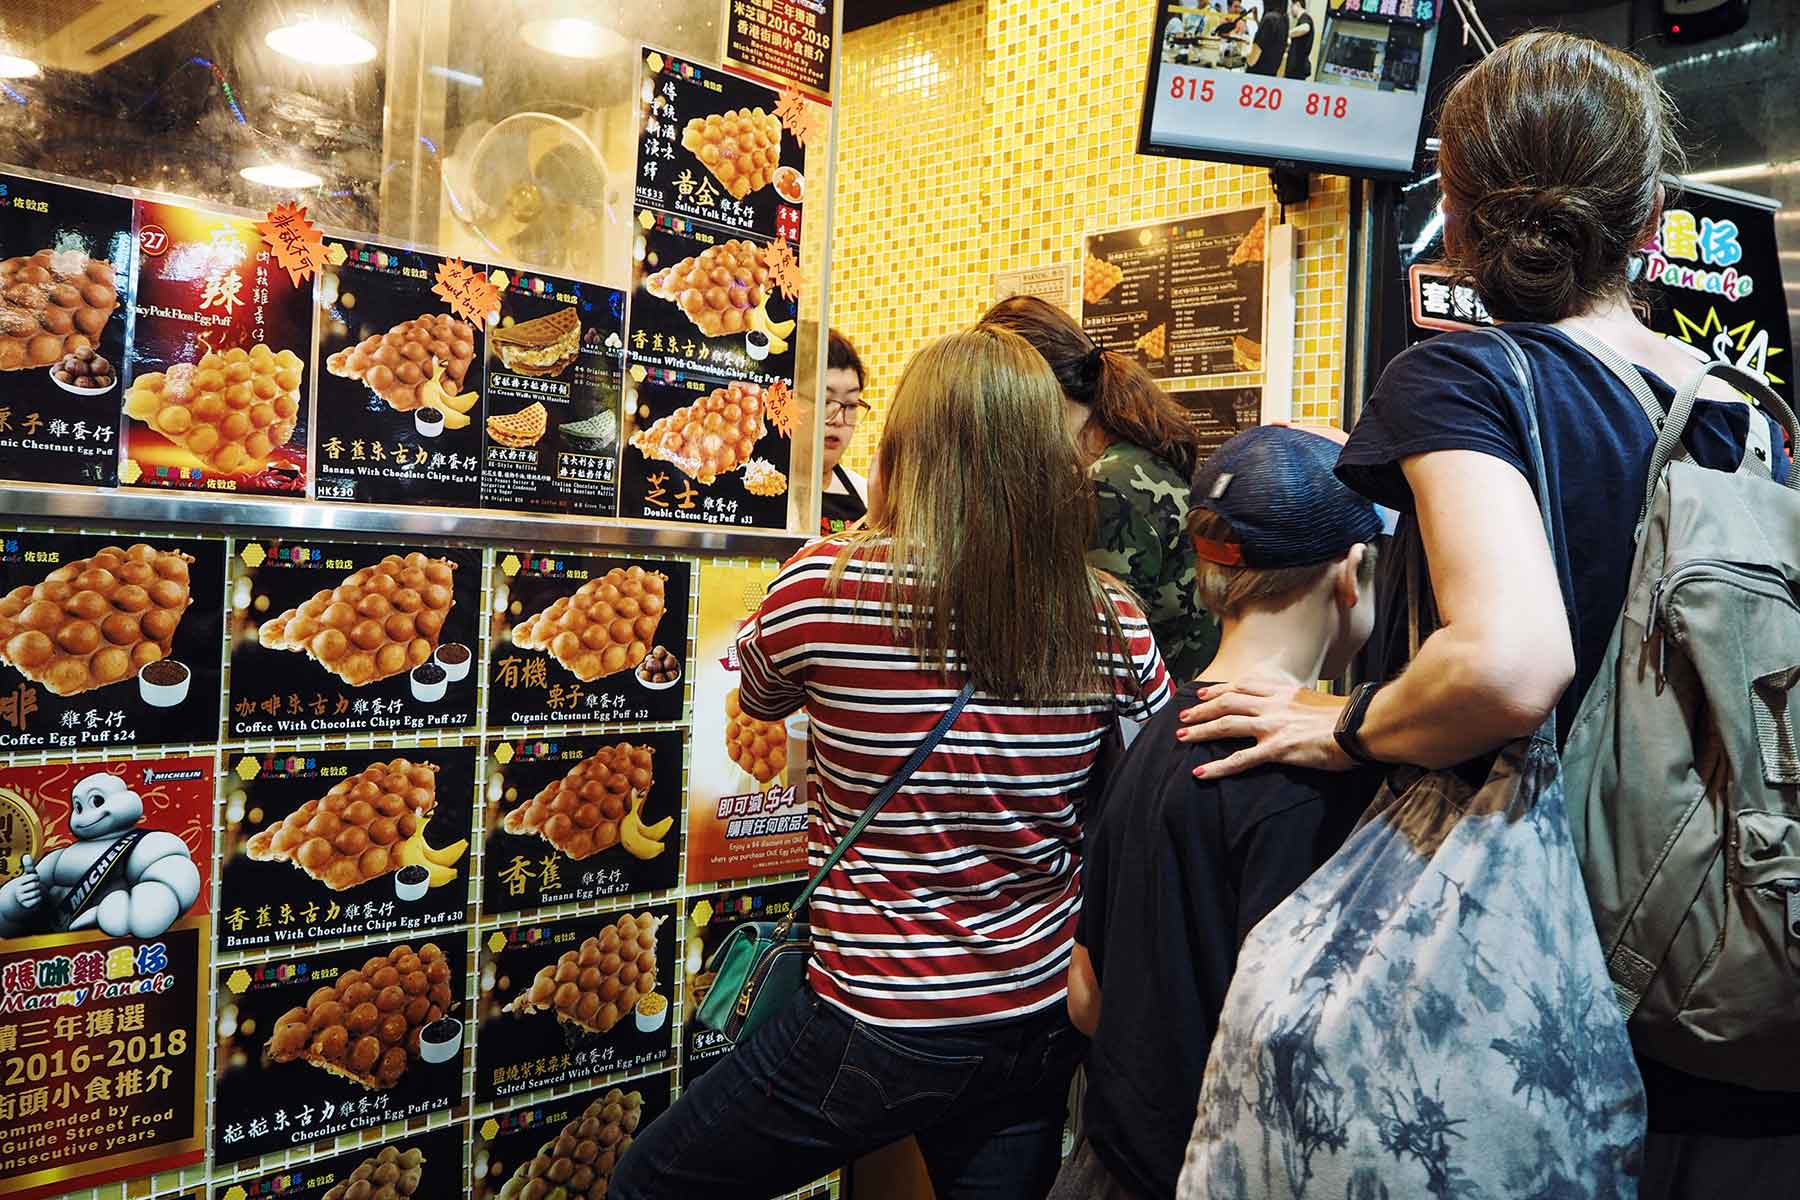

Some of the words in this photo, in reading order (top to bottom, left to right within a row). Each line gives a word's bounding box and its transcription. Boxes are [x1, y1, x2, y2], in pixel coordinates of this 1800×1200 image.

[732, 41, 763, 58] Michelin
[757, 58, 798, 77] consecutive
[1170, 76, 1215, 102] 815
[1239, 84, 1282, 110] 820
[1305, 92, 1347, 118] 818
[672, 168, 720, 207] 黃金
[674, 200, 700, 214] Salted
[702, 206, 720, 220] Yolk
[721, 212, 737, 226] Egg
[140, 231, 165, 249] $27
[1648, 253, 1754, 302] Pancake
[150, 305, 172, 319] Pork
[172, 308, 194, 321] Floss
[194, 311, 212, 327] Egg
[212, 314, 233, 327] Puff
[632, 351, 662, 364] Banana
[749, 371, 763, 384] Egg
[22, 439, 74, 453] Chestnut
[77, 446, 94, 456] Egg
[96, 447, 114, 456] Puff
[322, 464, 355, 475] Banana
[357, 466, 380, 476] With
[382, 468, 425, 480] Chocolate
[426, 471, 450, 483] Chips
[451, 473, 464, 483] Egg
[317, 486, 354, 497] HK$30
[644, 471, 699, 509] 芝士
[644, 507, 673, 518] Double
[674, 509, 701, 521] Cheese
[703, 512, 718, 524] Egg
[720, 513, 736, 523] Puff
[495, 655, 548, 690] 有機
[59, 708, 126, 729] 雞蛋仔
[235, 721, 273, 733] Coffee
[277, 720, 308, 731] With
[310, 718, 367, 730] Chocolate
[369, 716, 401, 729] Chips
[403, 715, 425, 728] Egg
[427, 713, 450, 725] Puff
[511, 711, 549, 724] Organic
[550, 710, 591, 721] Chestnut
[593, 710, 611, 722] Egg
[612, 709, 632, 719] Puff
[0, 733, 45, 747] Coffee
[49, 733, 77, 746] Egg
[81, 730, 111, 743] Puff
[154, 771, 202, 781] MICHELIN
[765, 785, 797, 812] $4
[70, 832, 139, 912] MICHELIN
[498, 852, 562, 897] 香蕉
[541, 892, 574, 904] Banana
[576, 889, 593, 900] Egg
[596, 885, 614, 896] Puff
[226, 935, 271, 947] Banana
[274, 929, 304, 942] With
[307, 923, 363, 938] Chocolate
[365, 918, 397, 931] Chips
[399, 915, 421, 928] Egg
[423, 912, 445, 924] Puff
[3, 942, 169, 995] 媽咪雞蛋仔
[0, 987, 89, 1015] Mammy
[91, 973, 176, 1001] Pancake
[4, 1029, 188, 1087] 2016-2018
[689, 1054, 700, 1062] Ice
[700, 1049, 721, 1059] Cream
[496, 1083, 526, 1096] Salted
[528, 1073, 566, 1089] Seaweed
[568, 1067, 591, 1080] With
[593, 1063, 614, 1074] Corn
[616, 1059, 633, 1070] Egg
[108, 1105, 129, 1118] by
[291, 1122, 347, 1143] Chocolate
[350, 1115, 381, 1130] Chips
[383, 1110, 405, 1123] Egg
[407, 1103, 429, 1116] Puff
[2, 1134, 63, 1155] Guide
[65, 1120, 124, 1141] Street
[131, 1109, 174, 1127] Food
[106, 1129, 156, 1150] years
